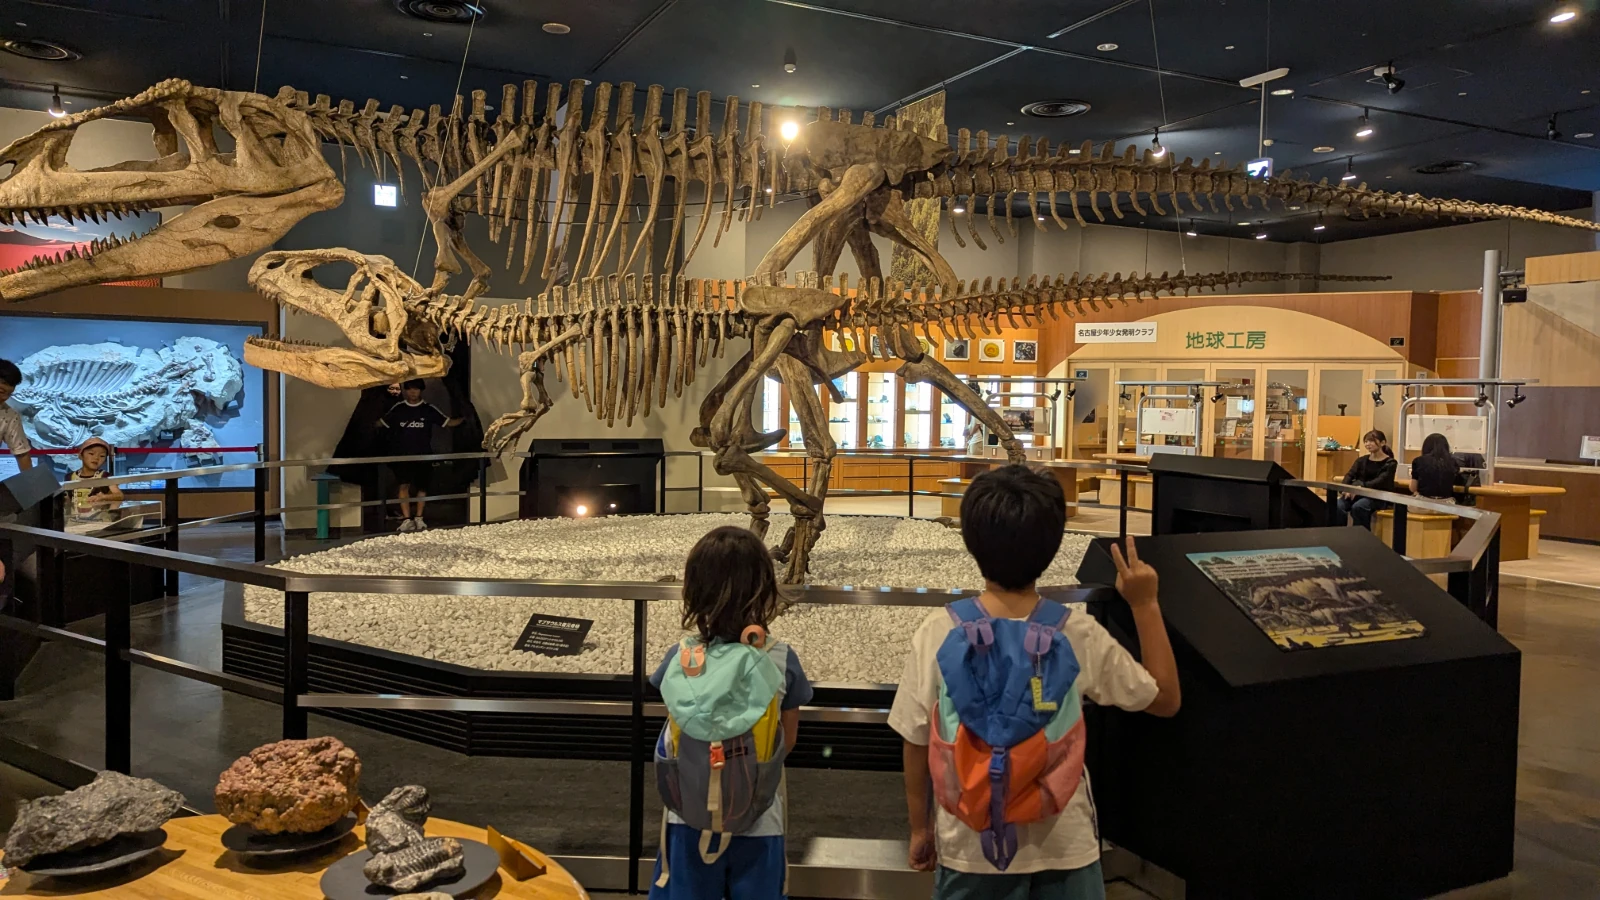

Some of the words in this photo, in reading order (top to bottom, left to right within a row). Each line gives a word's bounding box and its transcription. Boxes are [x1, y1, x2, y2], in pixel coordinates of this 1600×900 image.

[1078, 328, 1154, 337] 名古屋少年少女発明クラブ
[1185, 330, 1267, 350] 地球工房
[400, 420, 425, 428] adas
[1030, 676, 1058, 711] L
